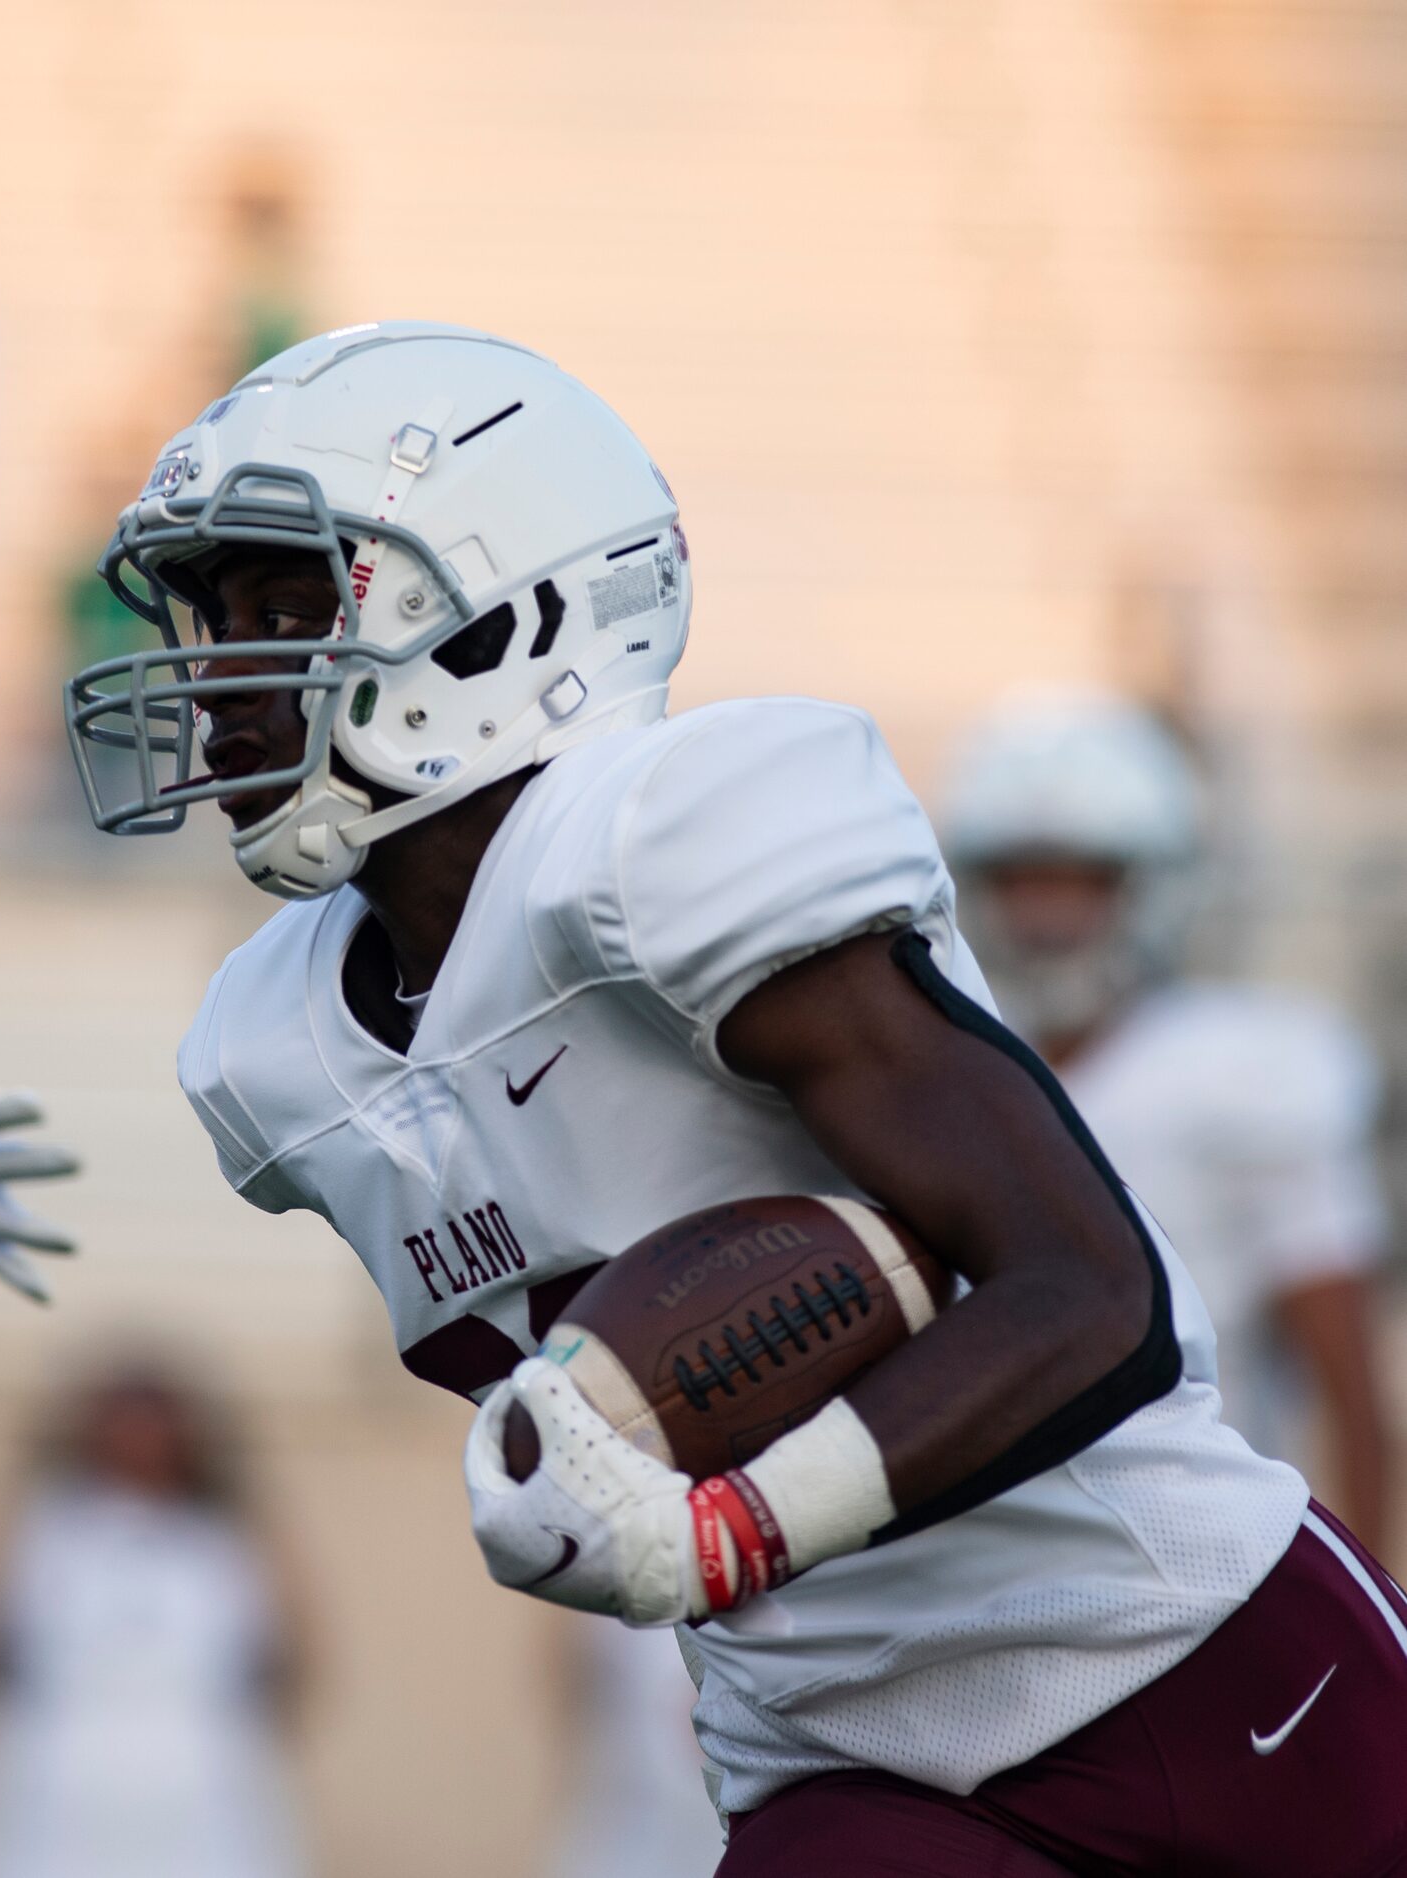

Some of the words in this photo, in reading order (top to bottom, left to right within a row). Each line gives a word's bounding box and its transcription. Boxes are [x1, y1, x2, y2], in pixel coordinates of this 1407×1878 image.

[626, 639, 650, 654] LARGE
[403, 1200, 527, 1303] PLANO
[655, 1222, 812, 1309] Wilson
